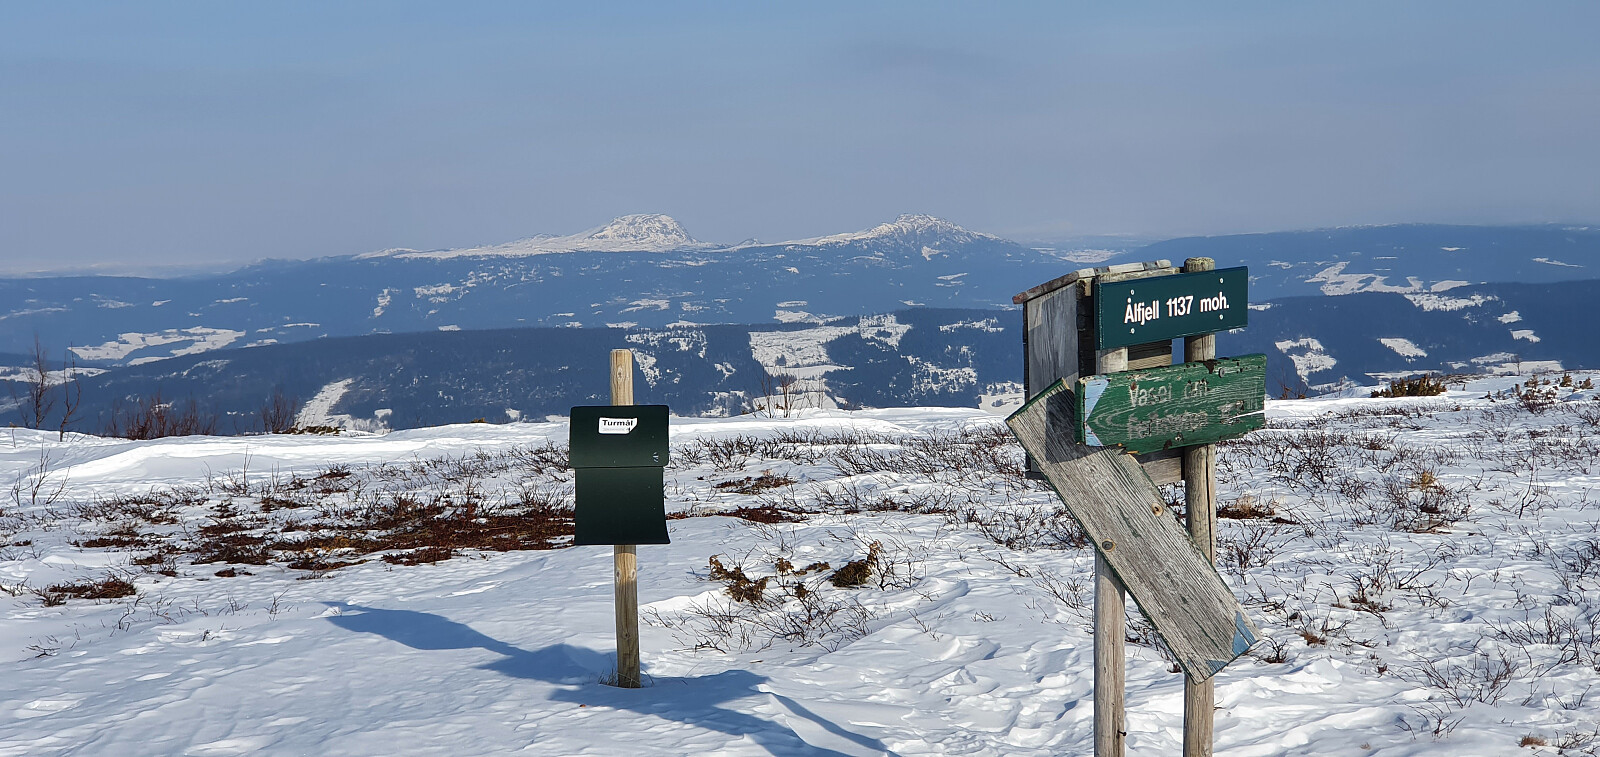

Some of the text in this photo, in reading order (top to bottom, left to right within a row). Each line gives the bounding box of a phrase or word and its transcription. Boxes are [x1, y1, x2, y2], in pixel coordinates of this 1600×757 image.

[1124, 292, 1230, 325] Ålfjell 1137 moh.
